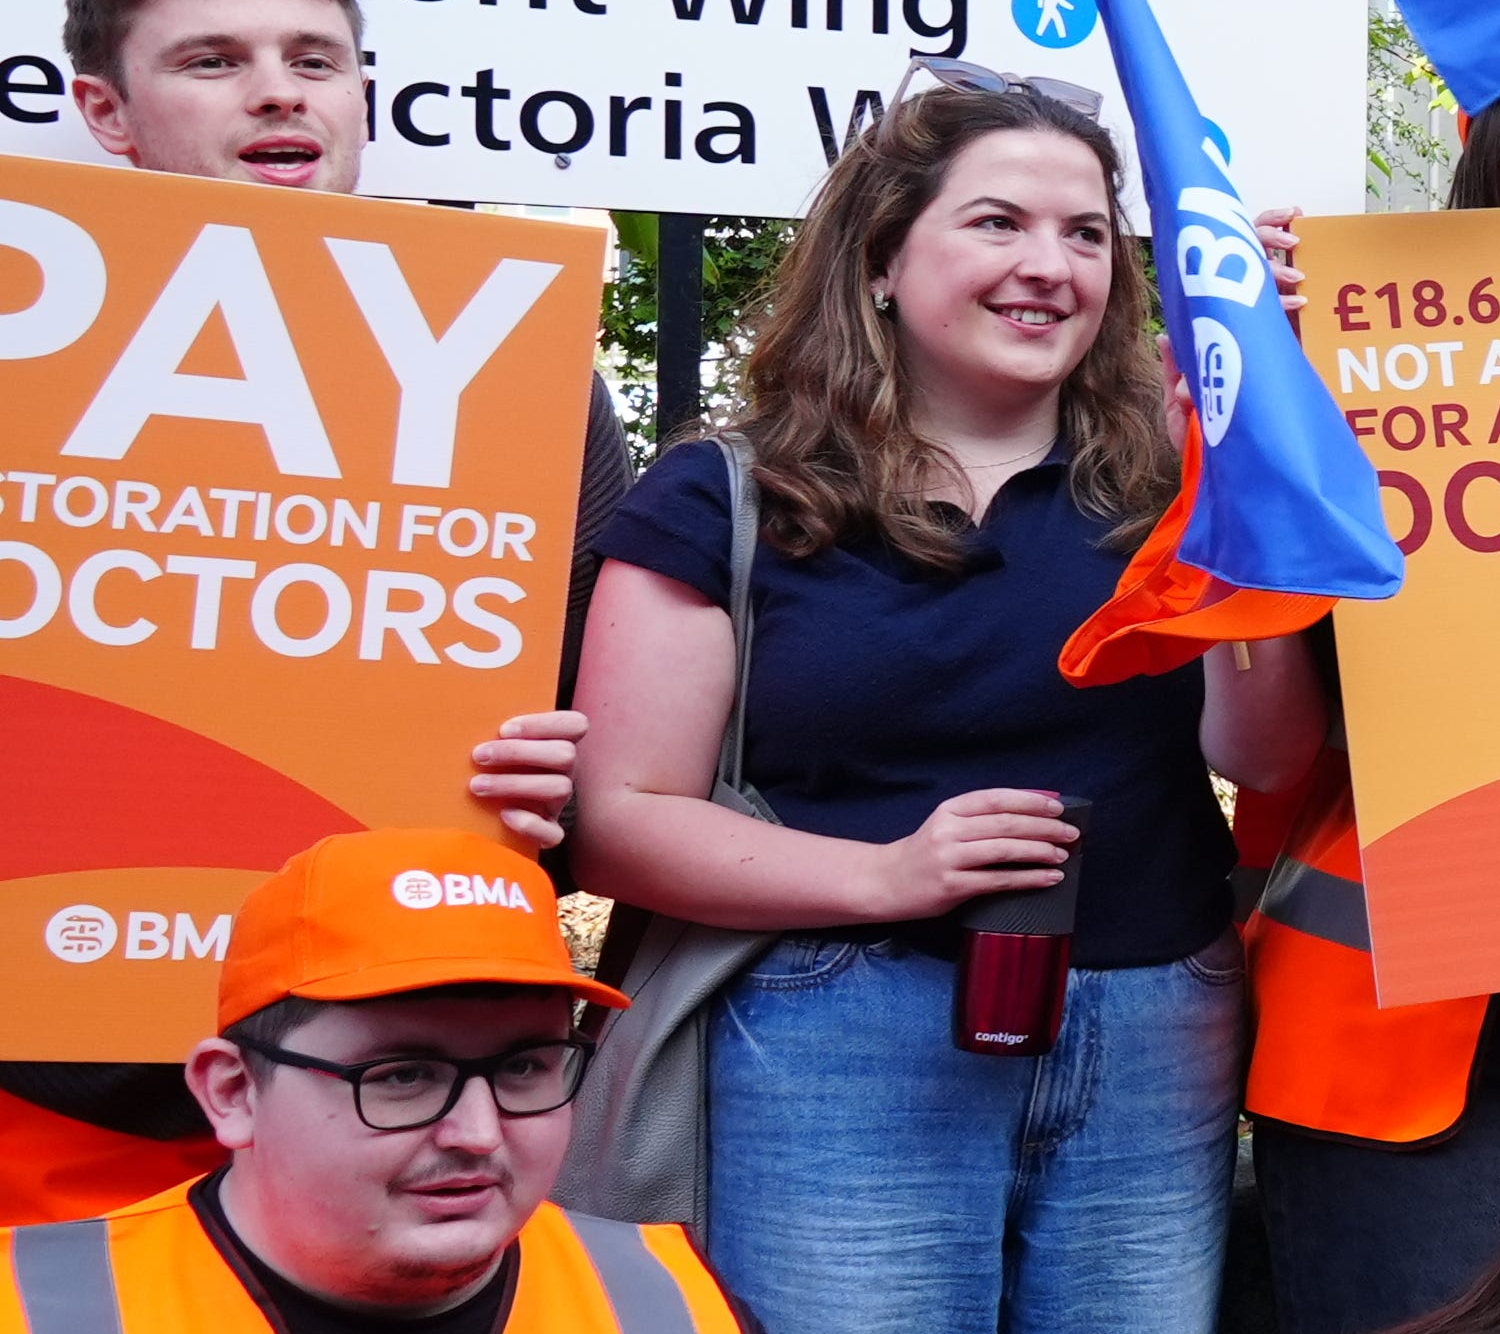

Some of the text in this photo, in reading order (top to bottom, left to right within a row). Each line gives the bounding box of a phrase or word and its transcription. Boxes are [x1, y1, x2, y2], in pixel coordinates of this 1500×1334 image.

[361, 51, 756, 164] ictoria
[1338, 342, 1463, 393] NOT
[1345, 403, 1471, 452] FOR
[0, 471, 536, 561] TORATION FOR
[0, 540, 525, 668] OCTORS
[444, 873, 533, 913] BMA
[126, 912, 229, 961] BM
